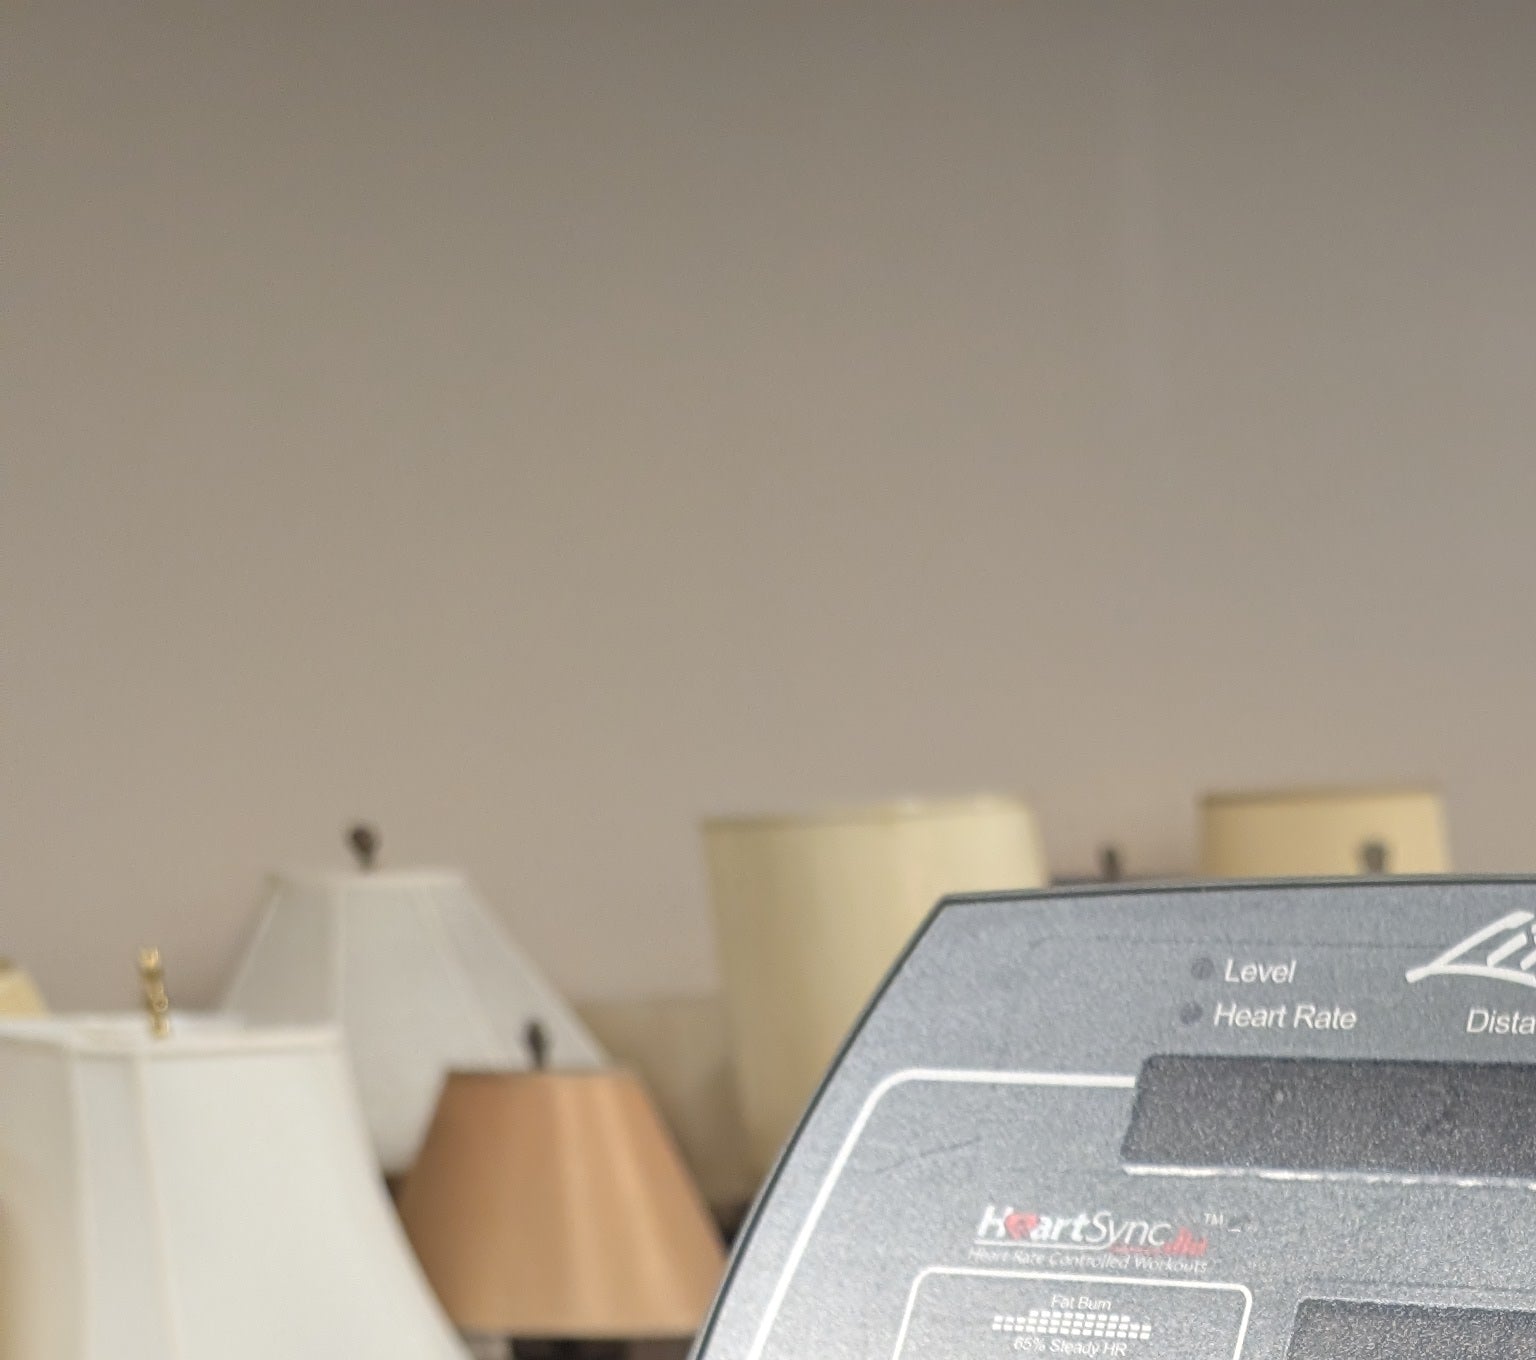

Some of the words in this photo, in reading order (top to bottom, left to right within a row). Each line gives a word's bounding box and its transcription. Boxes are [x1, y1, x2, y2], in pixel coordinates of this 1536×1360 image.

[1223, 958, 1296, 983] Level
[1212, 1002, 1286, 1028] Heart
[1293, 1004, 1357, 1031] Rate
[1048, 1251, 1131, 1270] Controlled
[1133, 1254, 1208, 1274] Workouts
[1050, 1294, 1076, 1310] Fat
[1078, 1295, 1113, 1312] Burn
[1013, 1336, 1046, 1352] 65%
[1050, 1338, 1099, 1357] Steady
[1102, 1340, 1128, 1357] HR
